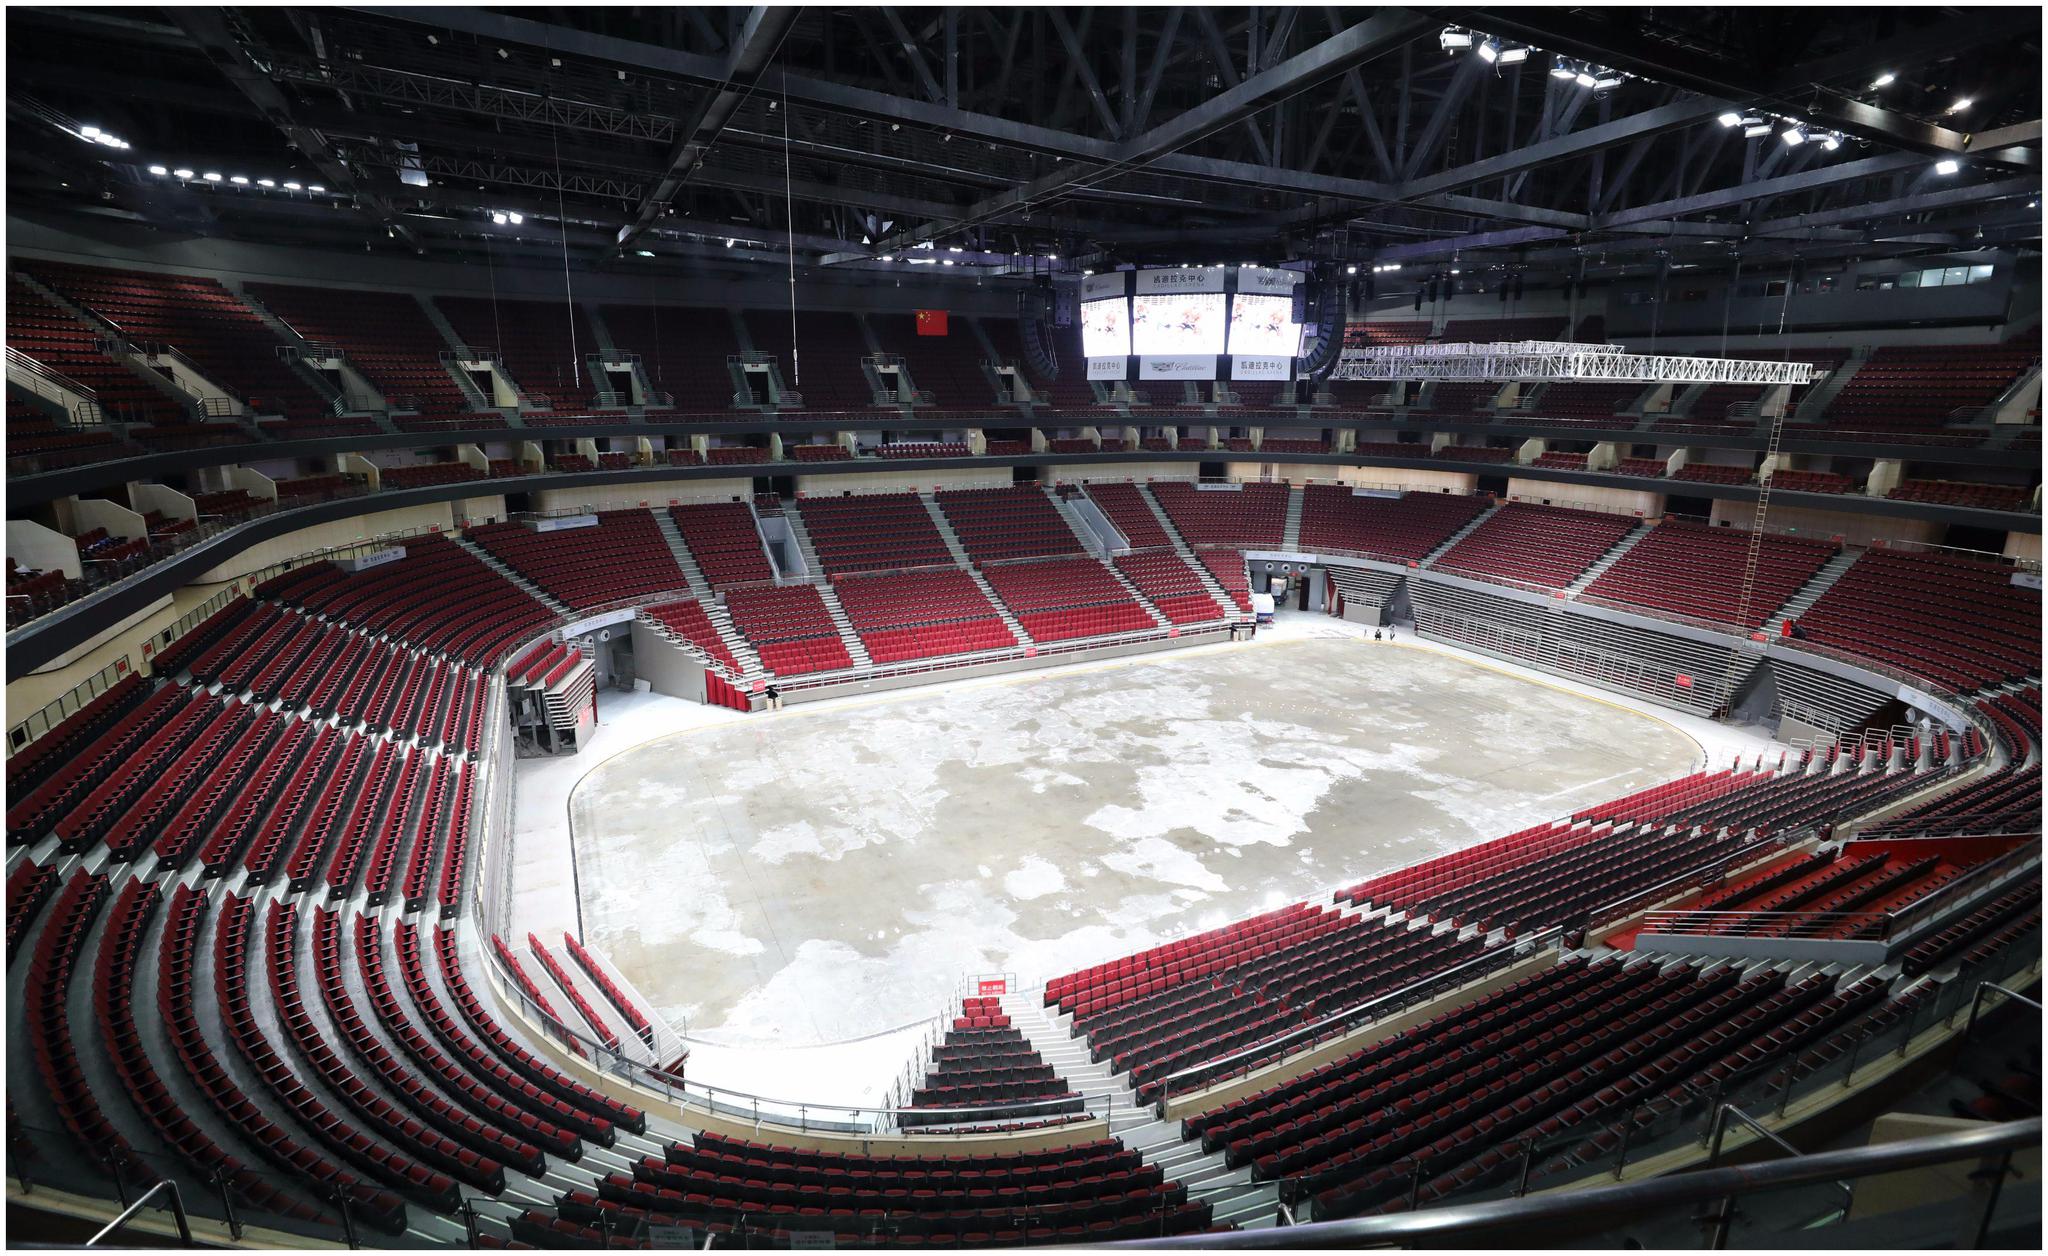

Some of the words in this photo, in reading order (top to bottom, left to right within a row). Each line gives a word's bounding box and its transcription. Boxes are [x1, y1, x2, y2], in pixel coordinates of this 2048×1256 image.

[1154, 274, 1205, 283] 凯迪拉克中心
